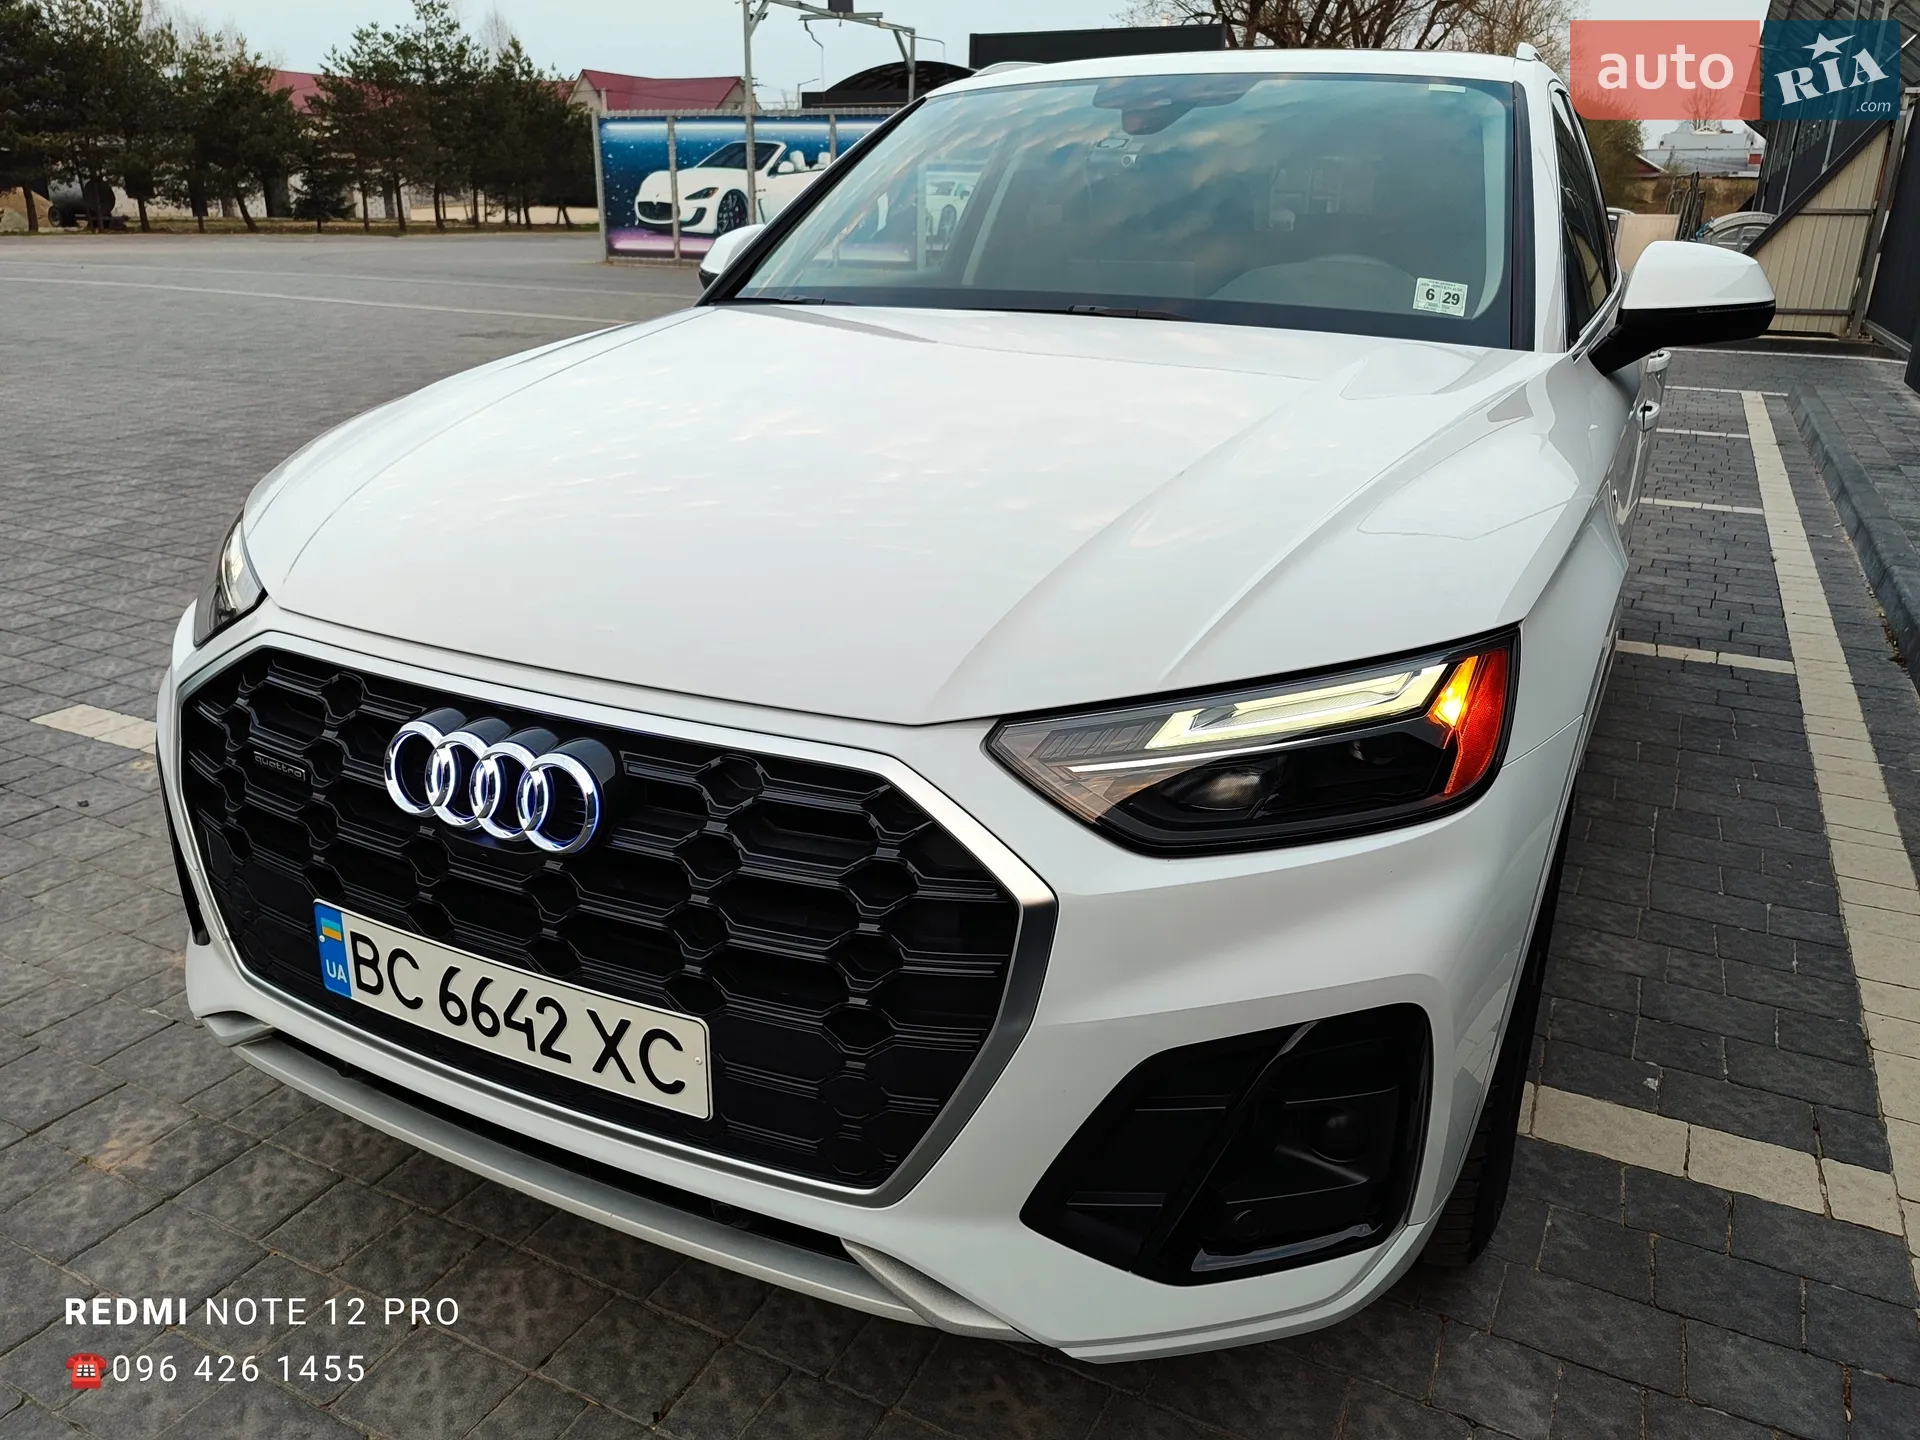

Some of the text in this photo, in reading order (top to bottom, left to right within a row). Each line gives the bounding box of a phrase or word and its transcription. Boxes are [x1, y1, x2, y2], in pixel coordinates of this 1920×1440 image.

[1425, 288, 1460, 306] 6 29
[254, 755, 302, 778] quattro
[326, 959, 347, 984] UA
[350, 931, 686, 1095] BC 6642 XC
